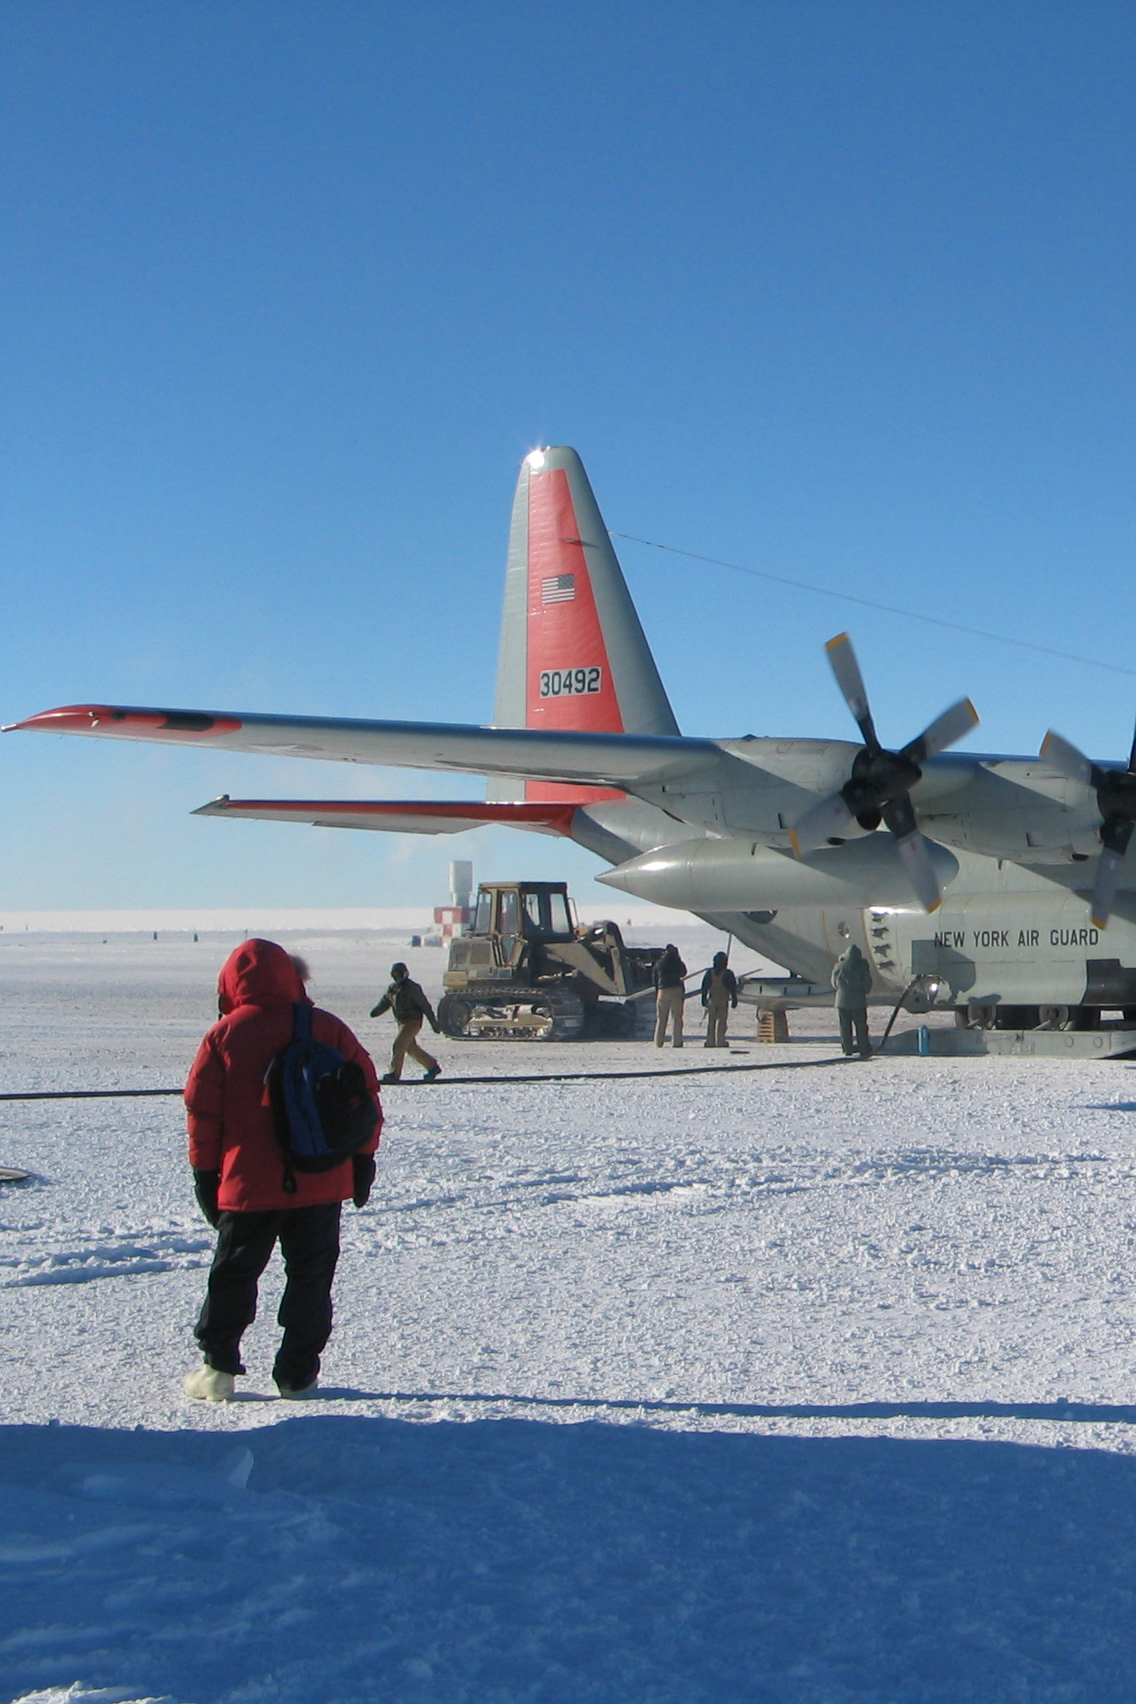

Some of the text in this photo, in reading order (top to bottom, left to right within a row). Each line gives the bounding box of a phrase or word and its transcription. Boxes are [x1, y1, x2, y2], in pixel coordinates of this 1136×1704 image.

[540, 668, 600, 697] 30492
[934, 928, 1099, 948] NEW YORK AIR GUARD
